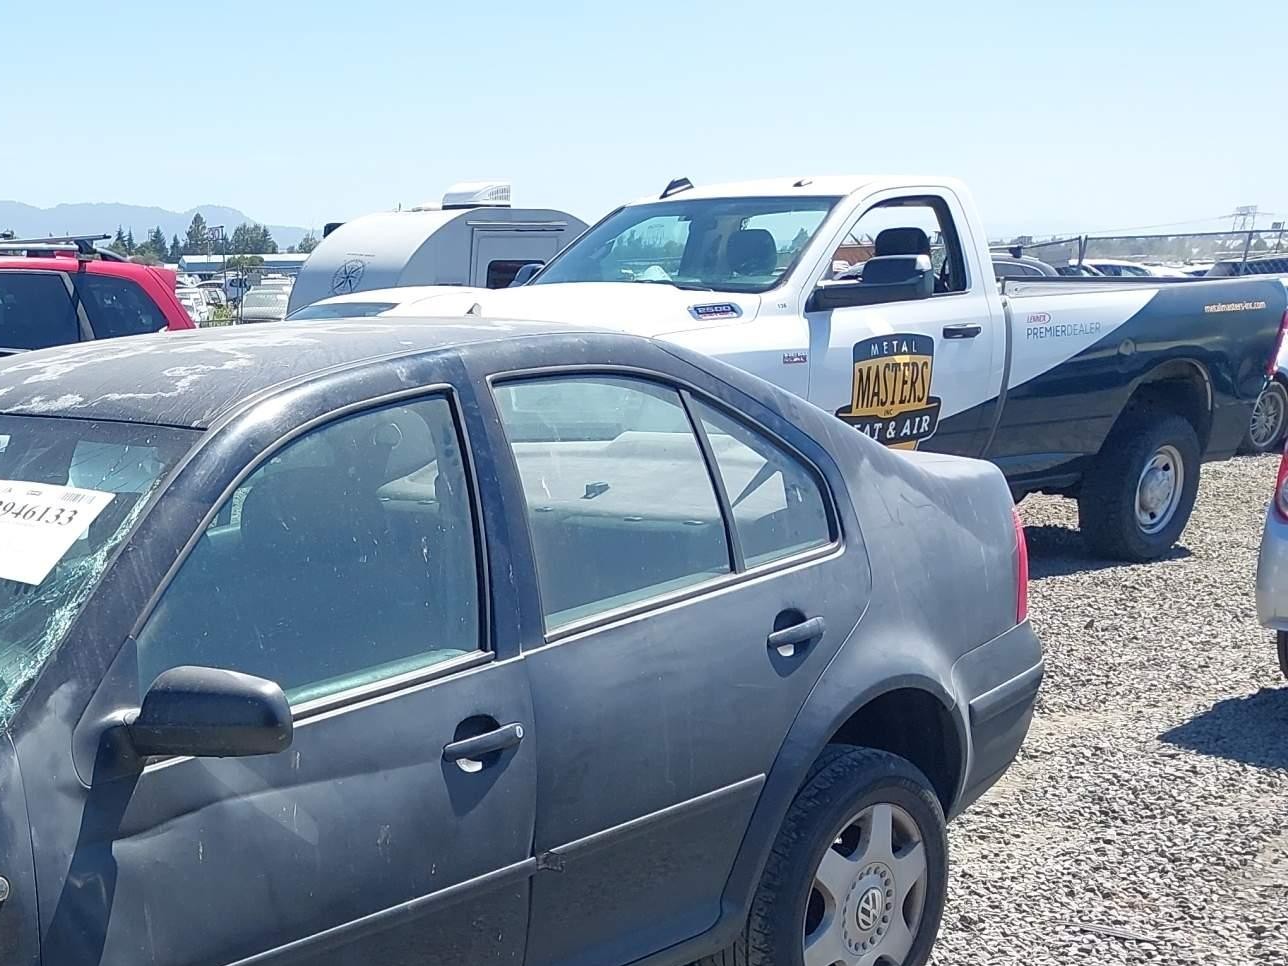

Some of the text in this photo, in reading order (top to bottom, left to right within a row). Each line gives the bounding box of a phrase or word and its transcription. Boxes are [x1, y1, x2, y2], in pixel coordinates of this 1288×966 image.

[698, 305, 732, 313] 2500
[1026, 322, 1101, 340] PREMIERDEALER
[871, 340, 917, 356] METAL
[855, 361, 929, 409] MASTERS
[853, 415, 931, 440] AT & AIR
